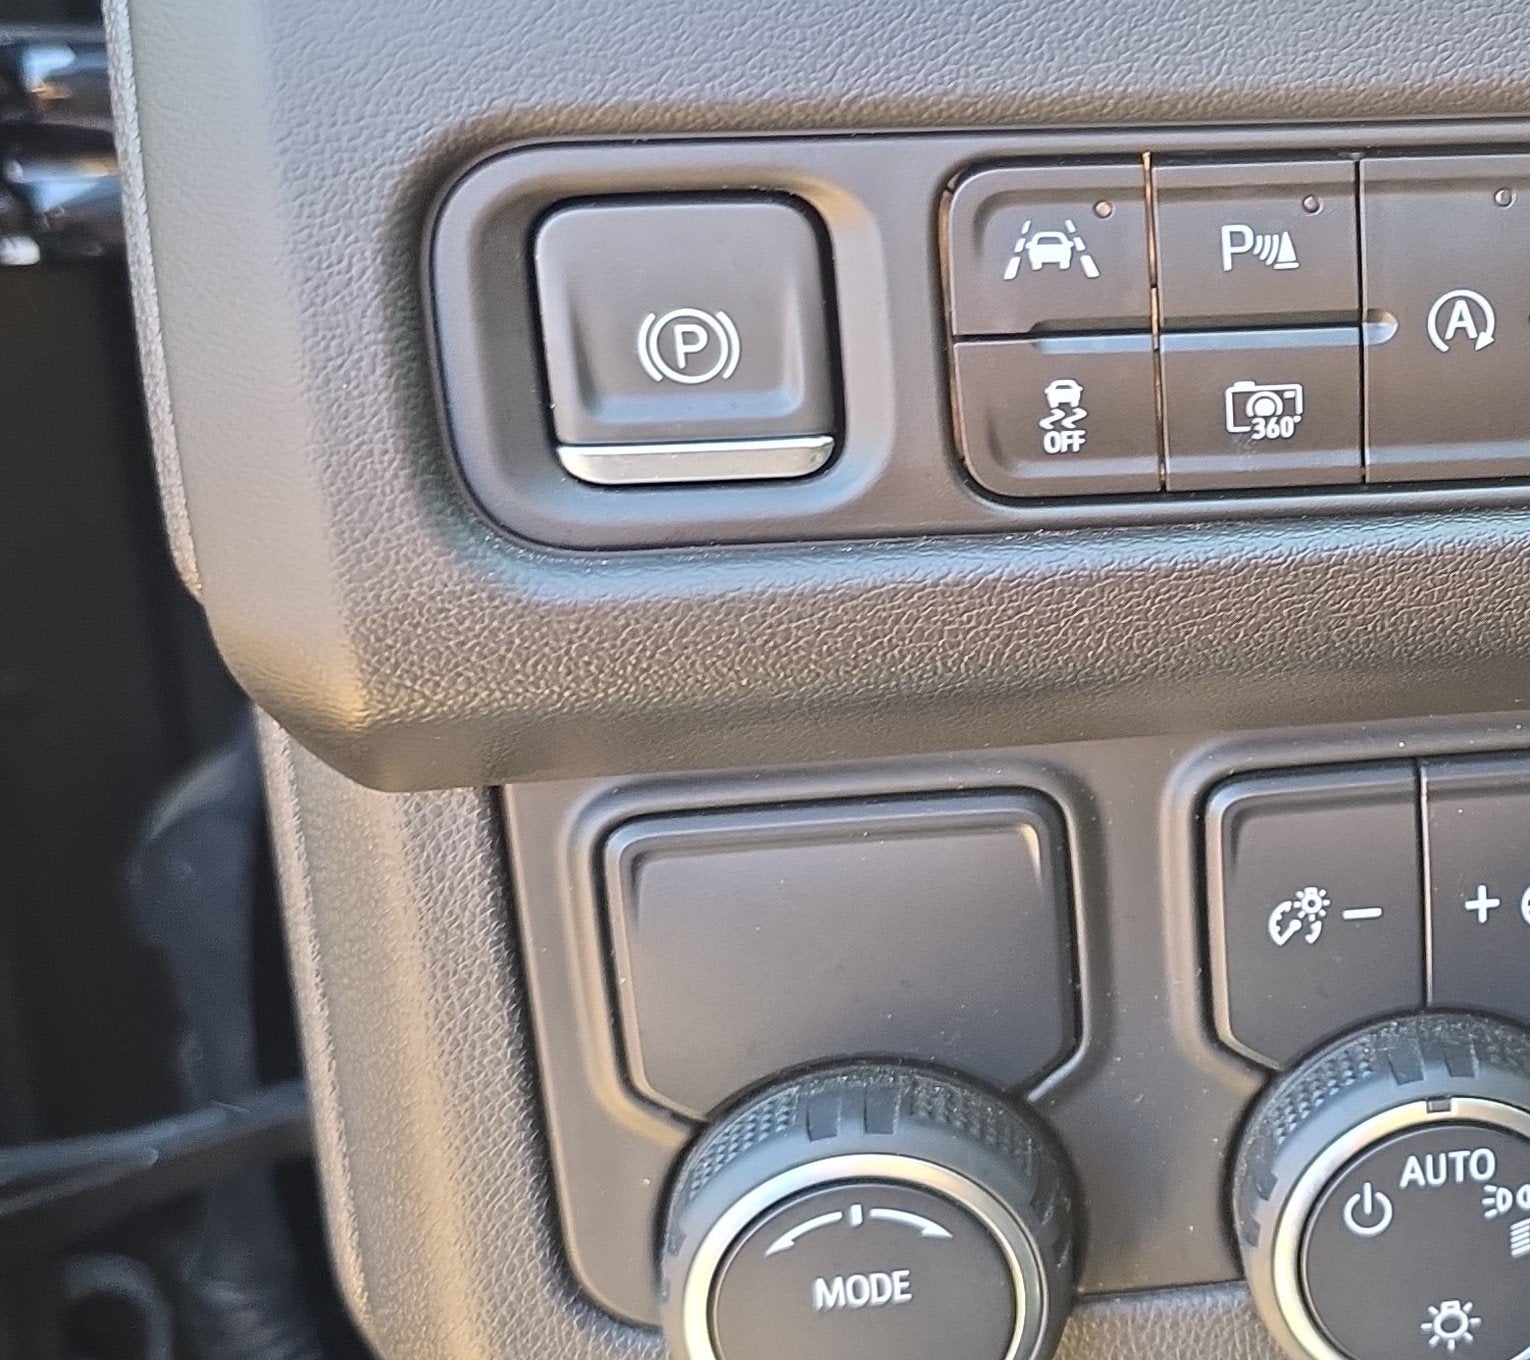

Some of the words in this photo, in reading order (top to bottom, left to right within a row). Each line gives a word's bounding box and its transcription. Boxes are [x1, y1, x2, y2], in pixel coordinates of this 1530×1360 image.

[1042, 429, 1087, 455] OFF
[1400, 1147, 1496, 1189] AUTO
[812, 1269, 913, 1311] MODE
